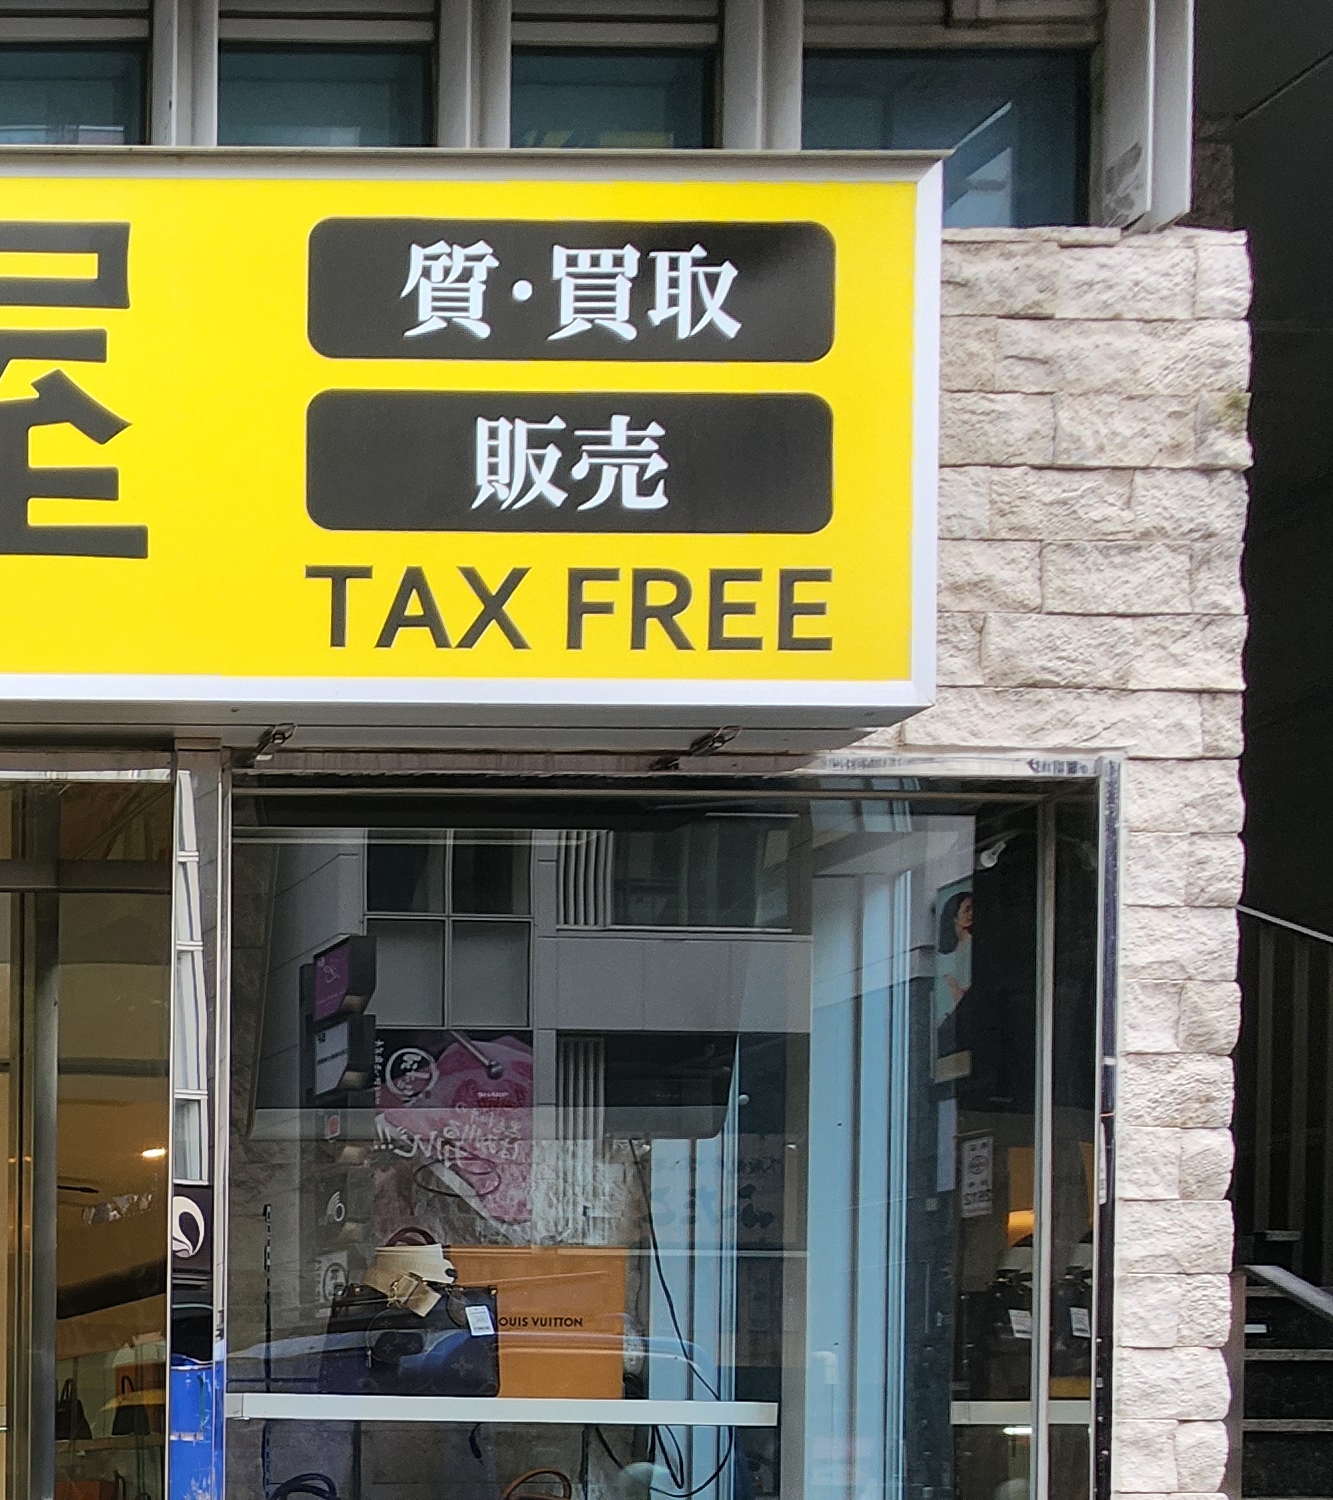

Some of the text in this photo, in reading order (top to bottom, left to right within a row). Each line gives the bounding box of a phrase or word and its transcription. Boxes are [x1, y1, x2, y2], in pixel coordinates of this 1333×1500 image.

[401, 239, 742, 342] 質・買取
[472, 414, 670, 513] 販売
[304, 565, 835, 652] TAX FREE
[498, 1316, 528, 1327] OUIS
[532, 1316, 584, 1327] VUITTON
